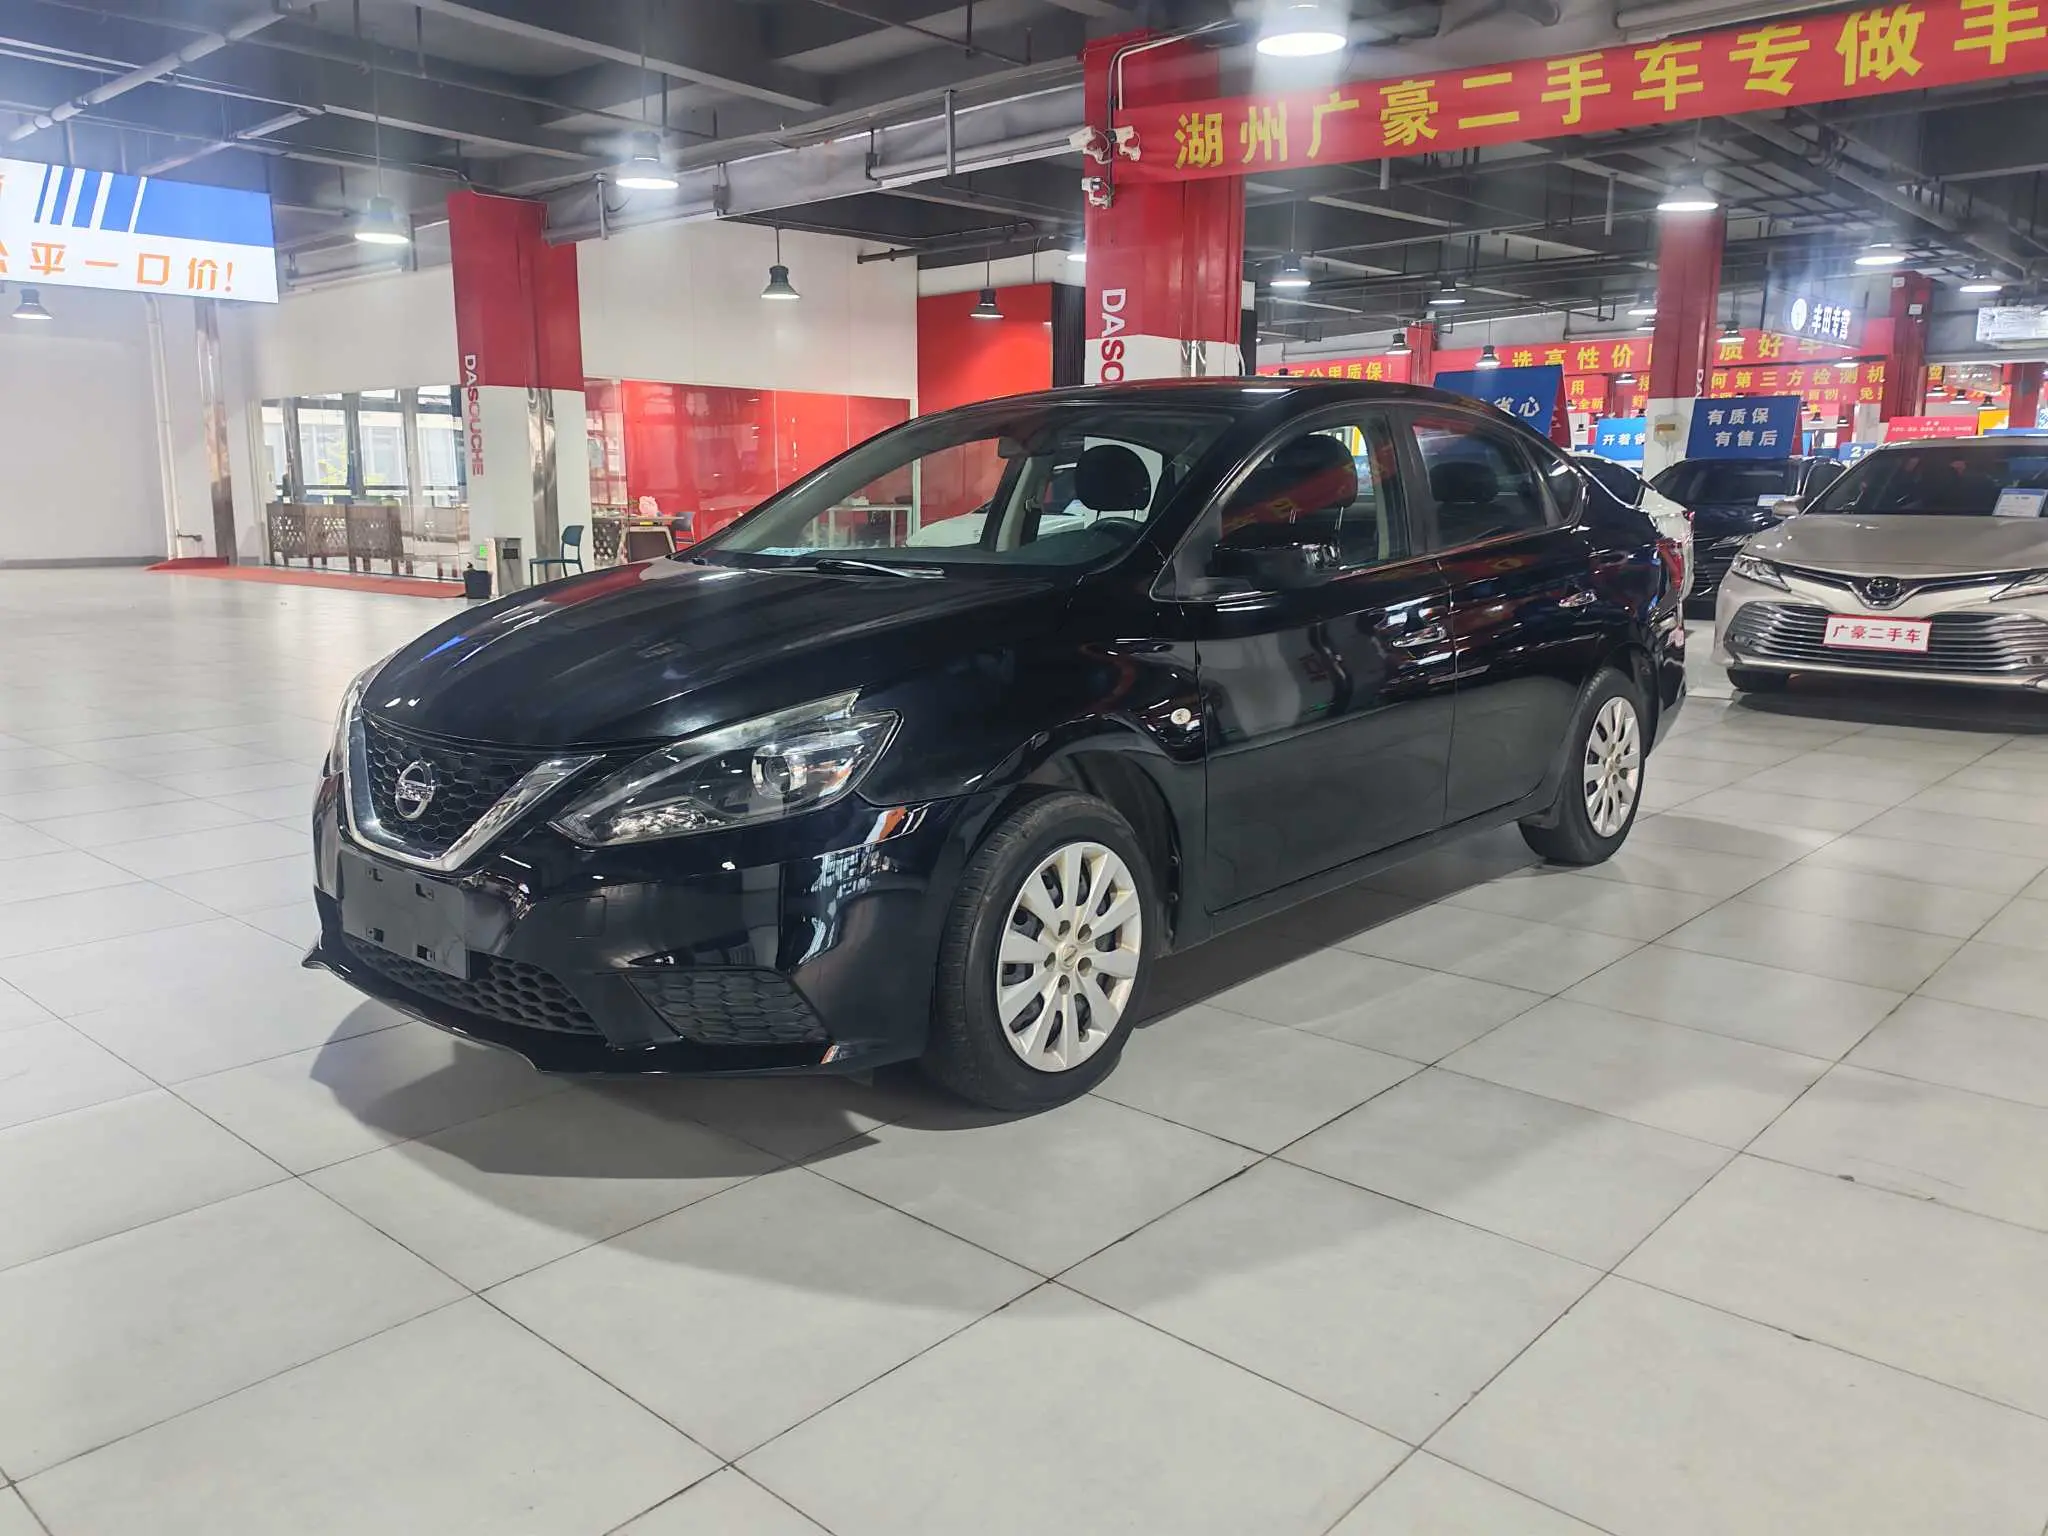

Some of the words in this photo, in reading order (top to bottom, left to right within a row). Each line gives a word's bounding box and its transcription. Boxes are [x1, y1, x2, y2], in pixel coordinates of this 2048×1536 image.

[0, 240, 234, 293] 平一口价!
[1494, 343, 1652, 370] 选高性价
[1707, 407, 1769, 426] 有质保
[1715, 430, 1778, 447] 有售后
[1833, 625, 1921, 643] 广豪二手车
